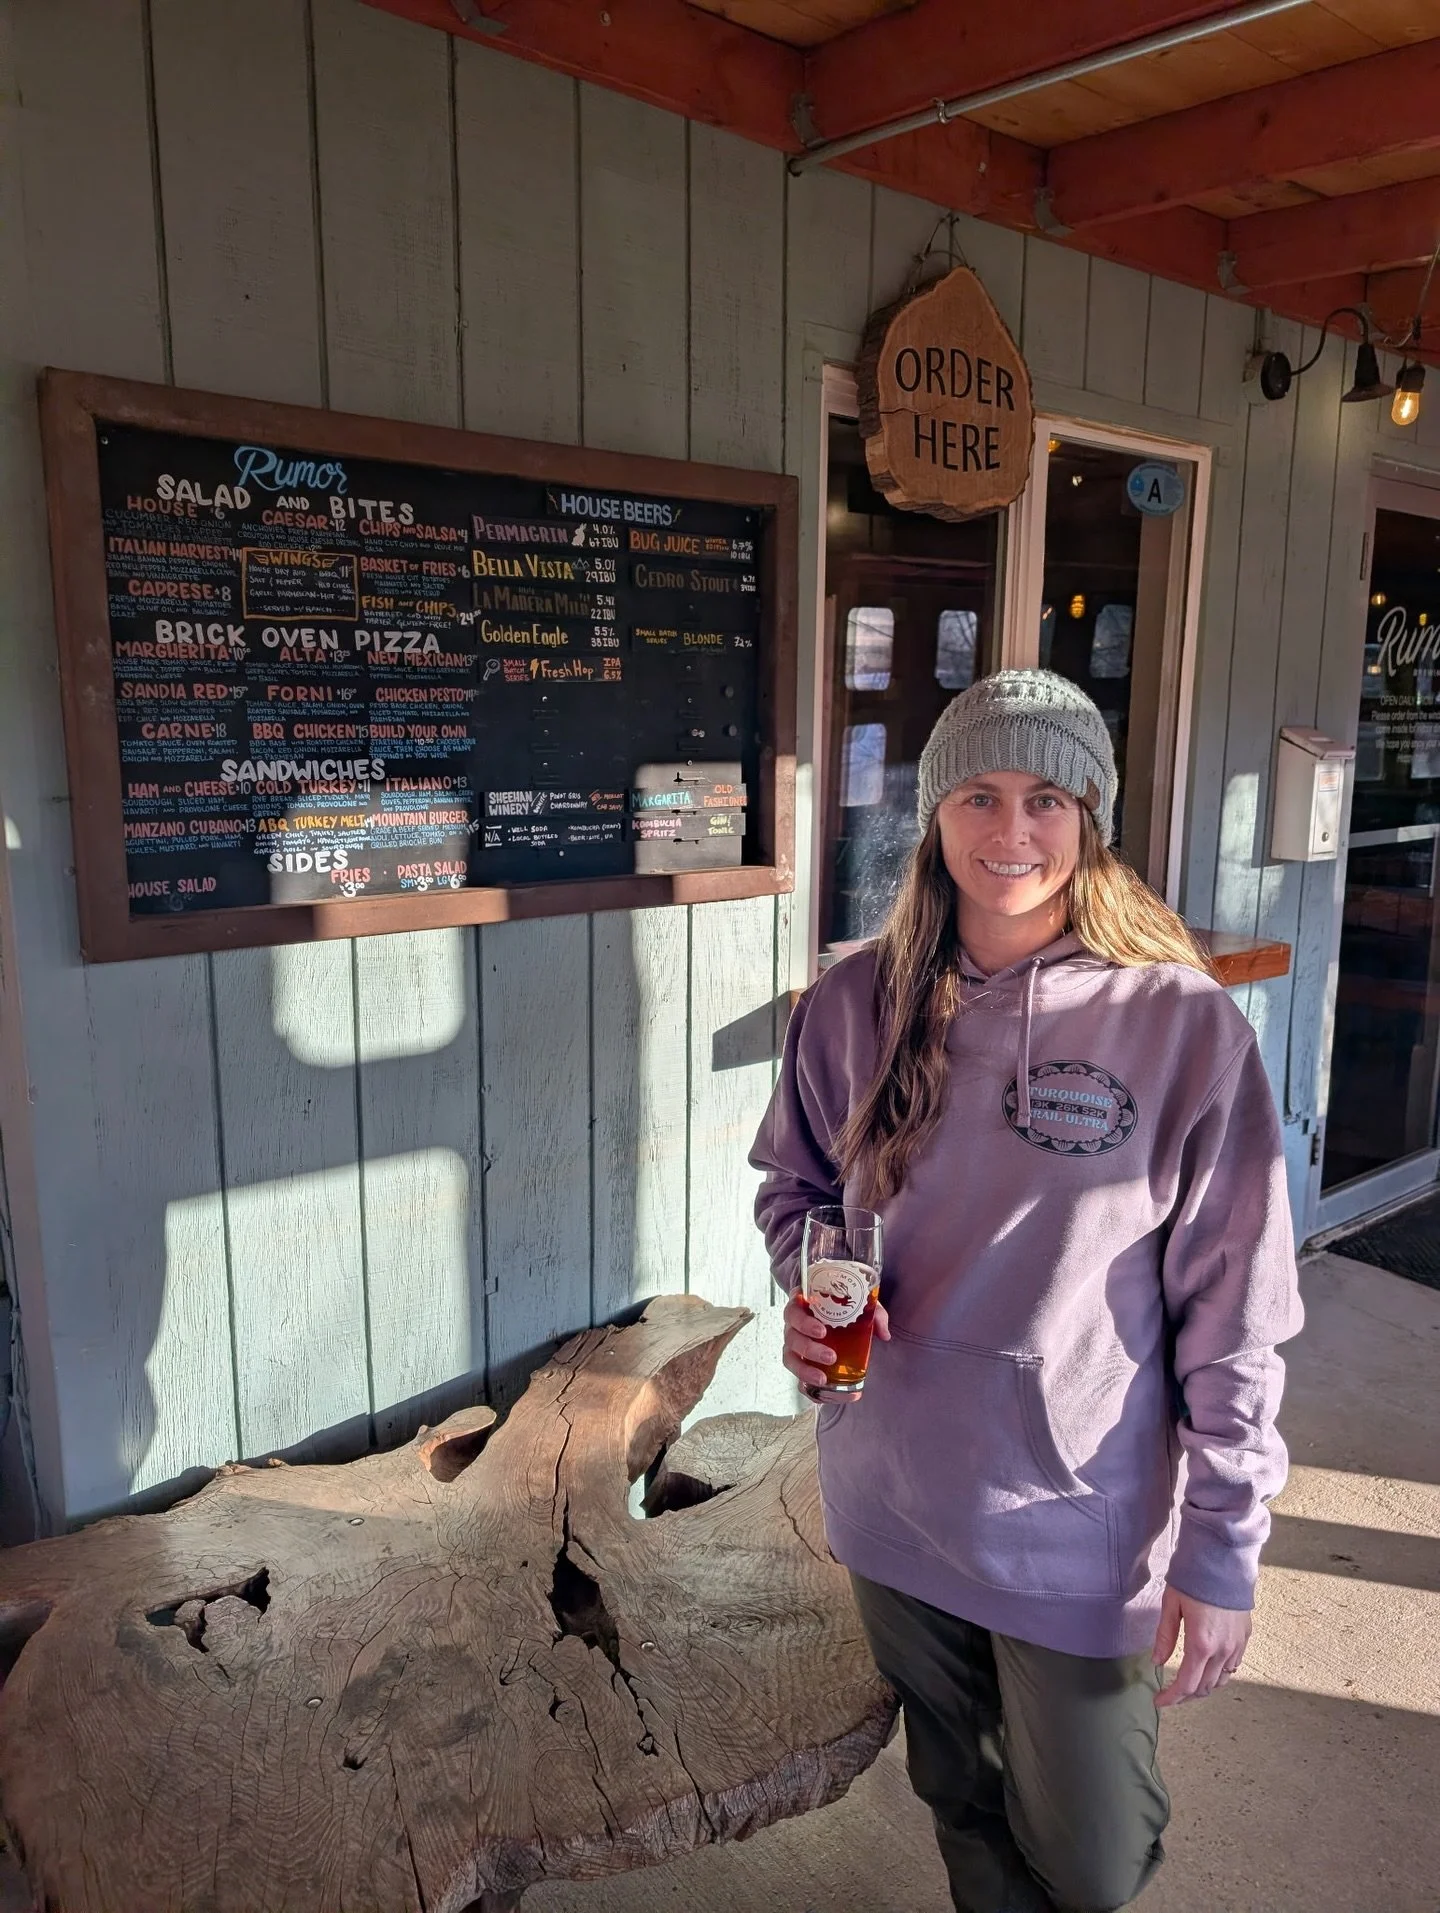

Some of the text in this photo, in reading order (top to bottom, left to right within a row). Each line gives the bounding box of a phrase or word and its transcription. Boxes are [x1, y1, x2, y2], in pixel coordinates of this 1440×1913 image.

[896, 346, 1015, 412] ORDER
[913, 414, 1001, 473] HERE
[233, 445, 348, 495] Rumor
[156, 473, 415, 526] SALAD AND BITES
[1147, 477, 1162, 505] A
[126, 495, 199, 518] HOUSE
[561, 492, 673, 527] HOUSE BEERS
[261, 509, 329, 531] CAESAR
[471, 514, 570, 544] PERMAGRIN
[358, 518, 458, 543] CHIPS SALSA
[592, 522, 616, 537] 4.0%
[108, 536, 167, 557] ITALIAN
[169, 541, 230, 561] HARVEST
[629, 529, 701, 556] BUG JUICE
[269, 551, 322, 568] WINGS
[360, 556, 458, 578] BASKET FRIES
[471, 548, 576, 581] BELLA VISTA
[594, 557, 617, 571] 5.0%
[635, 562, 731, 593] CEDRO STOUT
[127, 579, 215, 600] CAPRESE
[473, 581, 492, 611] LA
[492, 584, 554, 614] MADERA
[359, 594, 458, 620] FISH CHIPS
[155, 619, 441, 655] BRICK OVEN PIZZA
[481, 618, 570, 649] Golden Eagle
[594, 625, 616, 638] 5.5%
[635, 627, 657, 638] SMALL
[682, 632, 725, 647] BLONDE
[115, 640, 230, 661] MARGHERITA
[279, 646, 327, 665] ALTA
[367, 650, 463, 669] NEW MEXICAN
[502, 658, 528, 668] SMALL
[540, 658, 595, 681] Fresh Hop
[602, 656, 622, 668] IPA
[504, 672, 531, 683] SERIES
[603, 668, 623, 682] 6.5%
[120, 682, 230, 701] SANDIA RED
[267, 685, 334, 703] FORNI
[375, 686, 465, 704] CHICKEN PESTO
[1380, 695, 1399, 706] OPEN
[140, 722, 213, 740] CARNE
[252, 722, 357, 740] BBQ CHICKEN
[369, 724, 468, 741] BUILD YOUR OWN
[186, 740, 206, 748] OVEN
[370, 739, 461, 748] STARTING AT CHOOSE
[395, 745, 472, 754] THEN CHOOSE MANY
[122, 755, 150, 764] ONION
[219, 758, 387, 784] SANDWICHES
[127, 780, 238, 799] HAM AND CHEESE
[255, 778, 358, 796] COLD TURKEY
[384, 775, 453, 792] ITALIANO
[714, 784, 734, 795] OLD
[177, 797, 206, 806] SLICED
[297, 793, 323, 802] SLICED
[317, 798, 359, 808] PROVOLONE
[488, 790, 534, 805] SHEEHAN
[549, 791, 582, 801] PINOT GRIS
[631, 789, 693, 809] MARGARITA
[488, 803, 531, 817] WINERY
[123, 818, 243, 839] MANZANO CUBANO
[257, 813, 367, 833] ABQ TURKEY MELT
[373, 809, 470, 830] MOUNTAIN BURGER
[631, 816, 684, 831] KOMBUCHA
[709, 815, 728, 827] GIN
[256, 830, 282, 841] GREEN
[370, 822, 440, 836] GRADE A BEEF SERVED
[484, 830, 501, 843] N/A
[530, 825, 549, 834] SODA
[640, 828, 677, 839] SPRITZ
[707, 825, 736, 836] TONIC
[321, 841, 365, 853] SOURDOUGH
[370, 840, 398, 851] GRILLED
[398, 837, 429, 849] BRIOCHE
[511, 833, 560, 844] LOCAL BOTTLED
[266, 848, 349, 874] SIDES
[397, 860, 469, 880] PASTA SALAD
[330, 866, 372, 885] FRIES
[400, 875, 449, 889] SM LG
[127, 875, 218, 899] HOUSE SALAD
[1029, 1086, 1113, 1108] TURQUOISE
[1029, 1108, 1109, 1132] RAIL ULTRA
[1055, 1103, 1079, 1114] 26K
[1081, 1107, 1106, 1119] 52K
